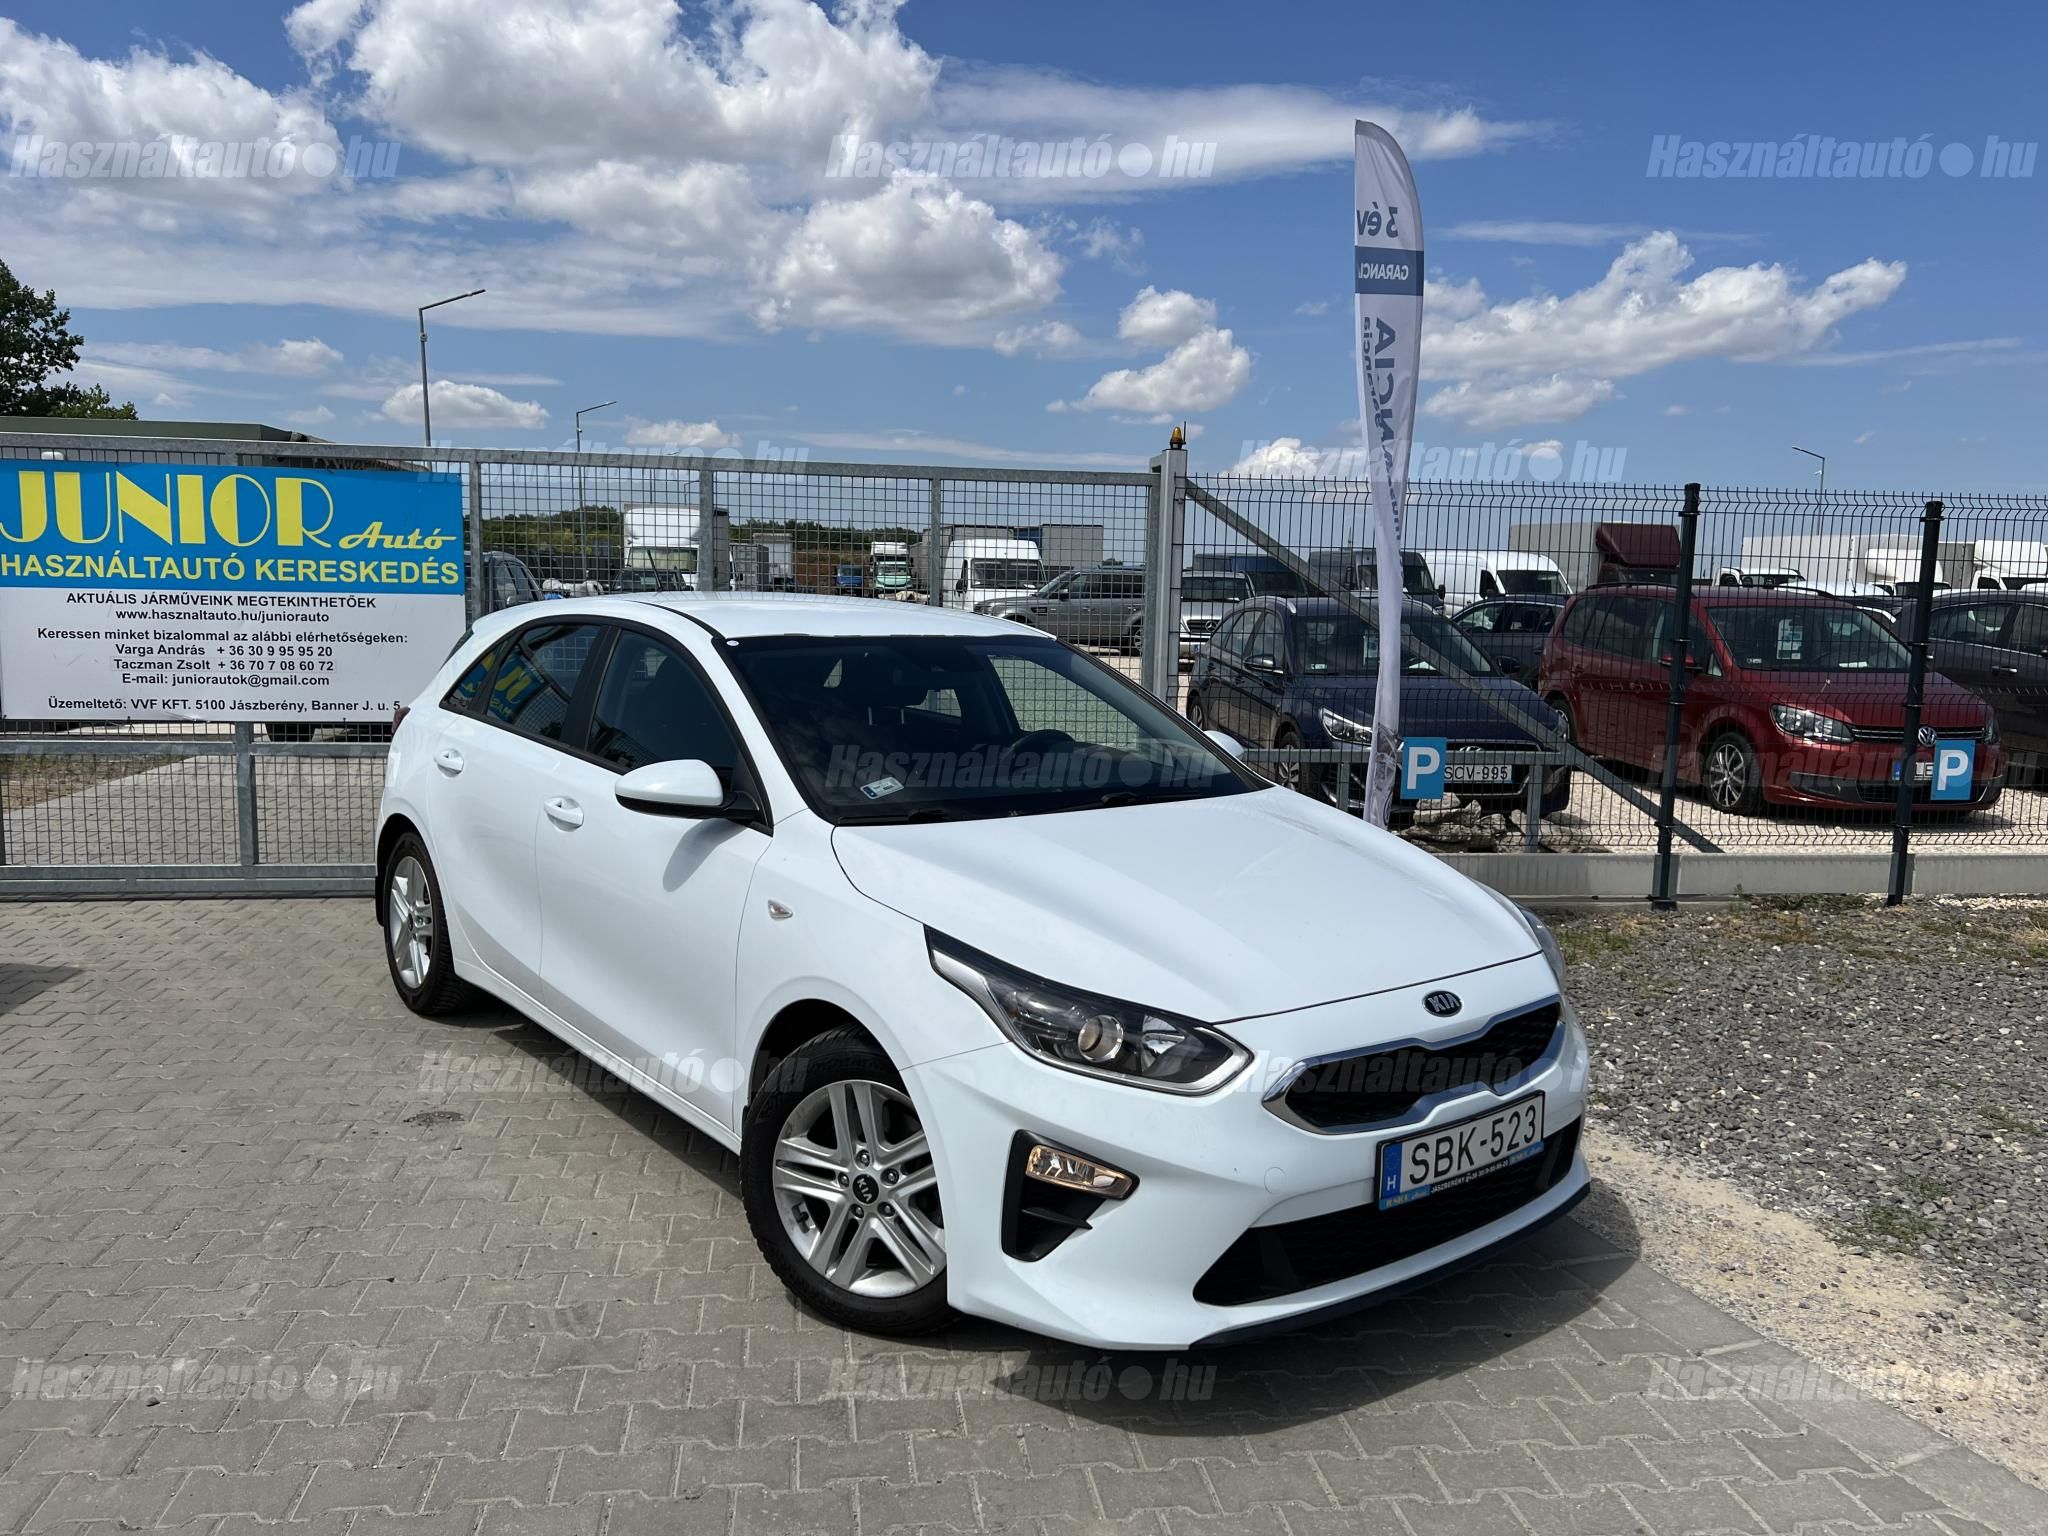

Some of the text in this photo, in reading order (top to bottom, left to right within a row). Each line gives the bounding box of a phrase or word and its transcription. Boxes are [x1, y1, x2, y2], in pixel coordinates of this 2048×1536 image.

[0, 470, 457, 550] JUNIOR Autó
[1, 550, 459, 585] HASZNÁLTAUTÓ KERESKEDÉS
[66, 591, 377, 609] AKTUÁLIS JÁRMŰVEINK MEGTEKINTHETŐEK
[116, 609, 330, 624] www.hasznaltauto.hu/juniorauto
[37, 628, 408, 646] Keressen minket bizalommal az alábbi elérhetőségeken:
[115, 644, 333, 658] Varga András + 36 30 9 95 95 20
[114, 659, 334, 671] Taczman Zsolt + 36 70 7 08 60 72
[122, 673, 330, 688] E-mail: juniorautok@gmail.com
[48, 695, 128, 710] Üzemeltető:
[131, 698, 158, 710] VVF
[162, 698, 191, 711] KFT.
[195, 699, 226, 711] 5100
[229, 699, 307, 714] Jászberény,
[311, 700, 359, 711] Banner
[362, 700, 374, 711] J.
[377, 702, 389, 711] u.
[1406, 746, 1440, 790] P
[1937, 749, 1969, 791] P
[1427, 993, 1460, 1013] KIA
[1409, 1104, 1537, 1185] SBK-523
[857, 1178, 873, 1202] KIA
[1386, 1174, 1397, 1192] H
